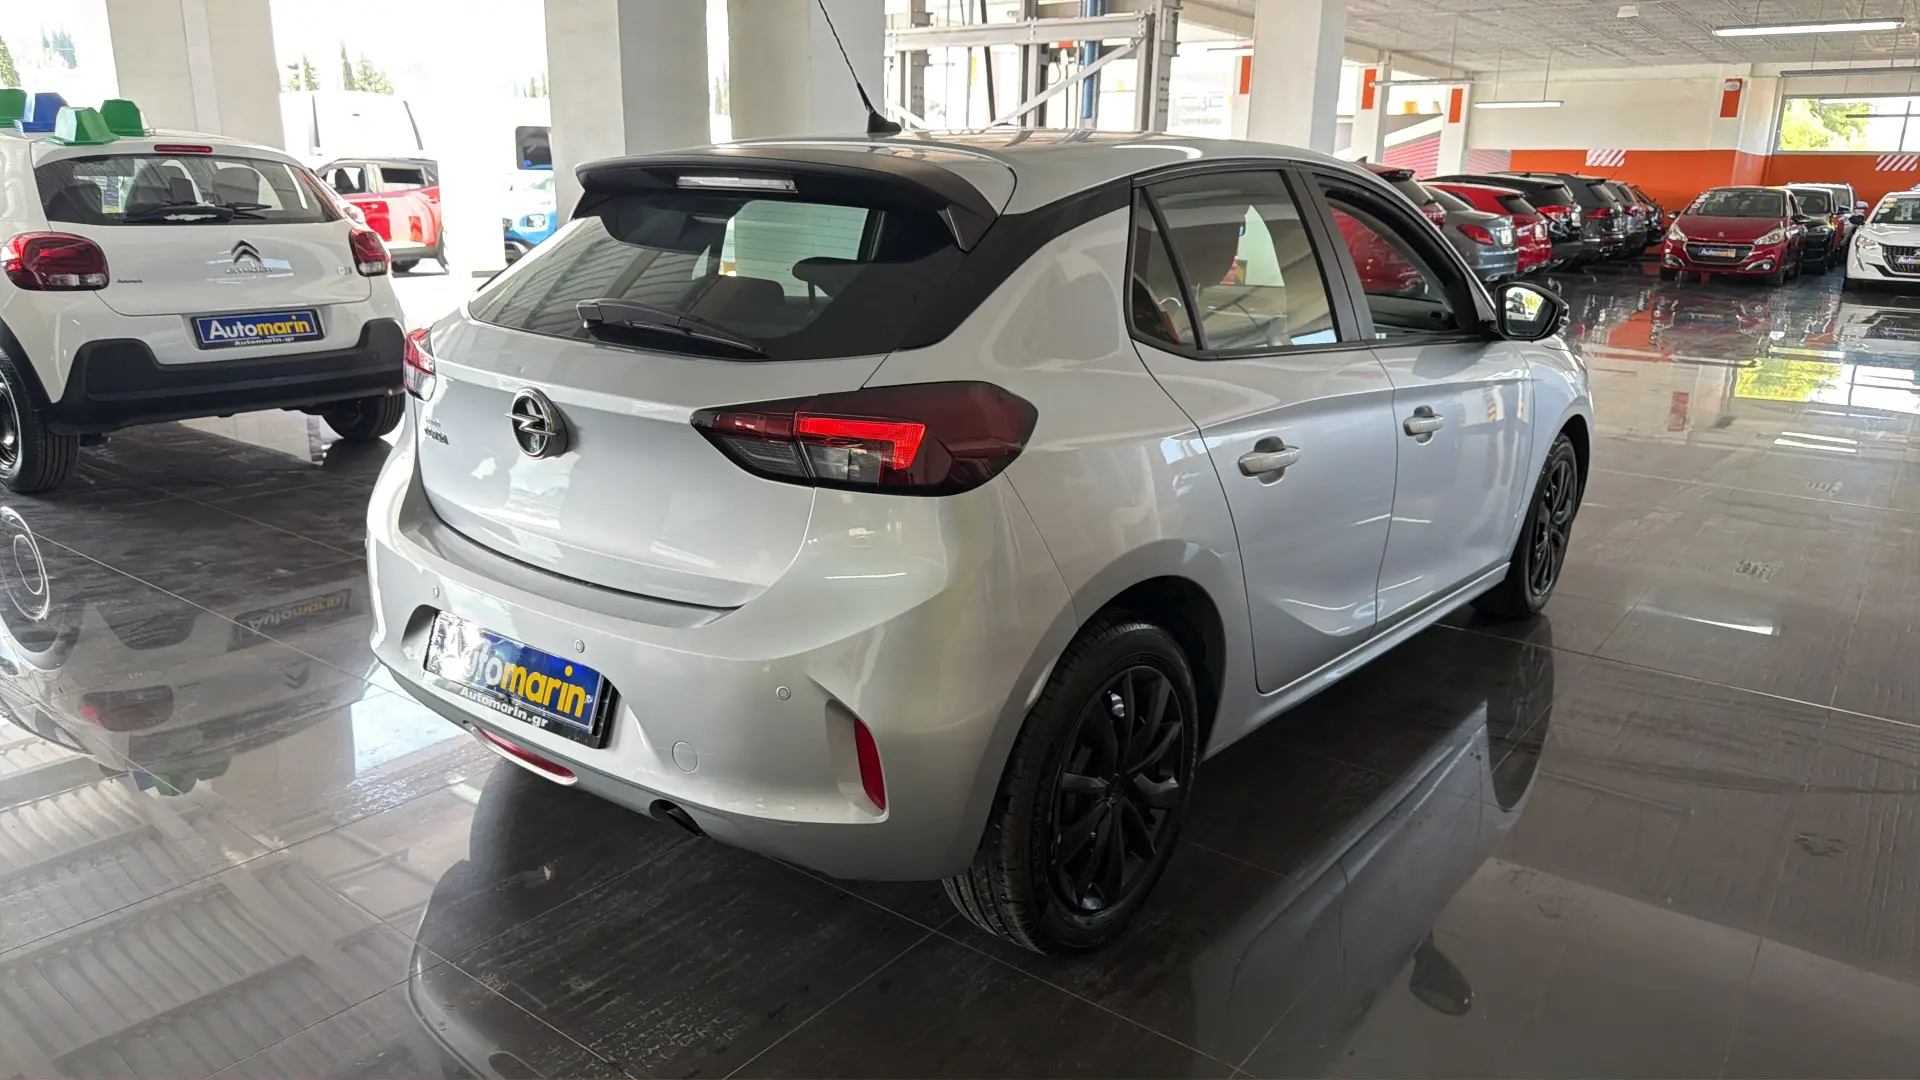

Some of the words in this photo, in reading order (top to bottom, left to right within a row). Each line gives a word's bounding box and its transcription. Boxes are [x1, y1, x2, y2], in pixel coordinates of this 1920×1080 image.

[210, 316, 310, 340] Automarin
[235, 337, 295, 346] Automarin.gr
[459, 687, 549, 728] Automarin.gr
